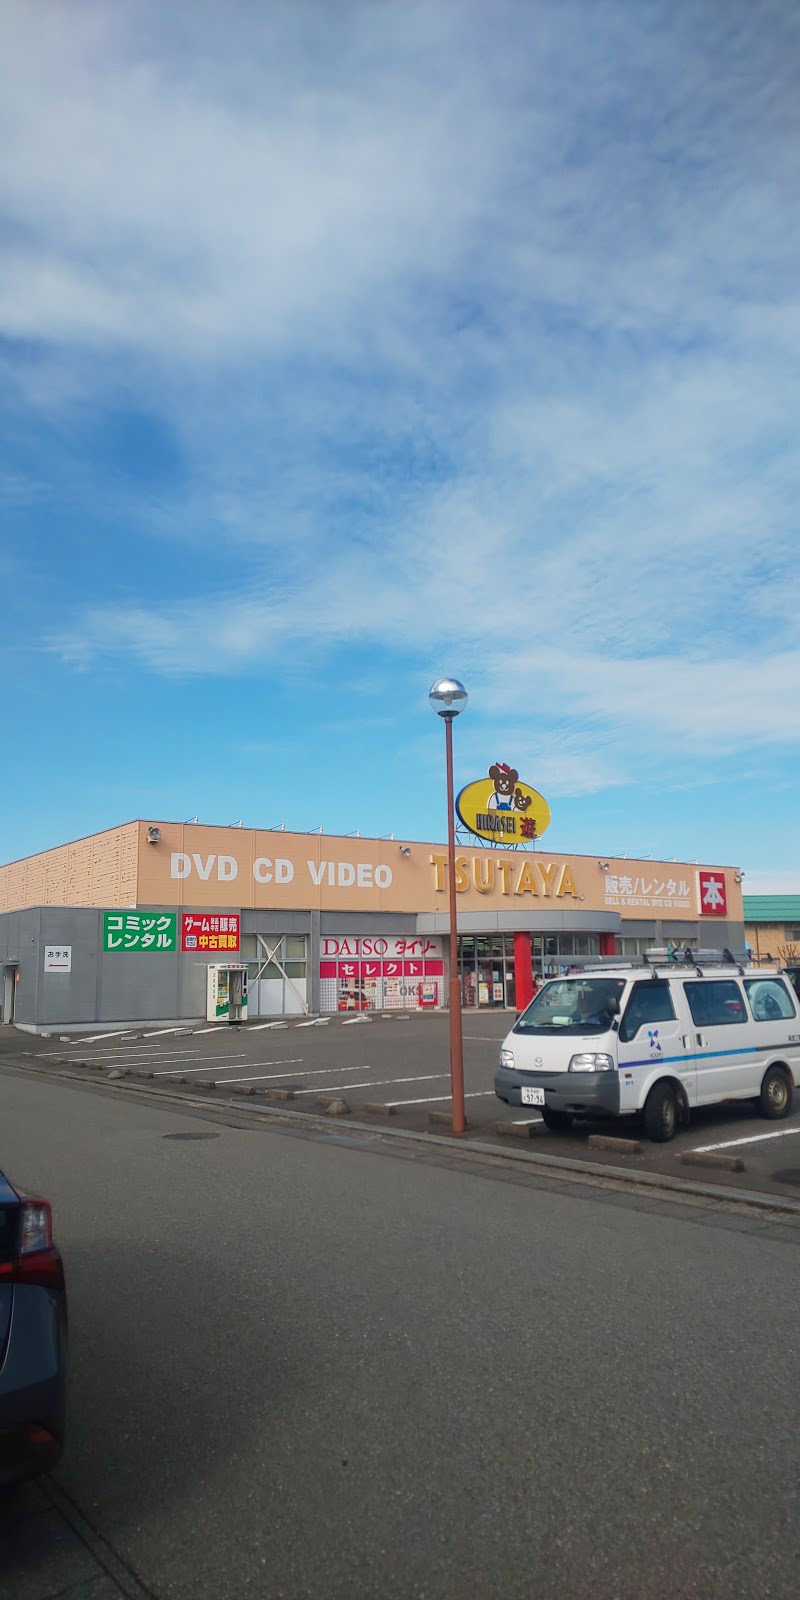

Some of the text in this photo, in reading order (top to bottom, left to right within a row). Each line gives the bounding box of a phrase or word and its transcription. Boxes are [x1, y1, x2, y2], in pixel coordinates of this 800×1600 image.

[476, 813, 537, 839] HIRASEI 遊
[170, 852, 393, 889] DVD CD VIDEO
[429, 854, 580, 899] TSUTAYA
[604, 874, 690, 897] 販売/レンタル
[702, 876, 725, 910] 本
[604, 896, 621, 906] SELL
[627, 898, 650, 908] RENTAL
[652, 899, 663, 908] DVD
[673, 900, 690, 909] VIDEO
[107, 915, 172, 932] コミック
[184, 916, 210, 932] ゲーム
[219, 917, 238, 933] 販売
[107, 933, 172, 949] レンタル
[198, 934, 237, 949] 中古買取
[322, 938, 437, 956] DAISO ダイソー
[47, 950, 69, 959] お手洗
[341, 962, 419, 976] セレクト
